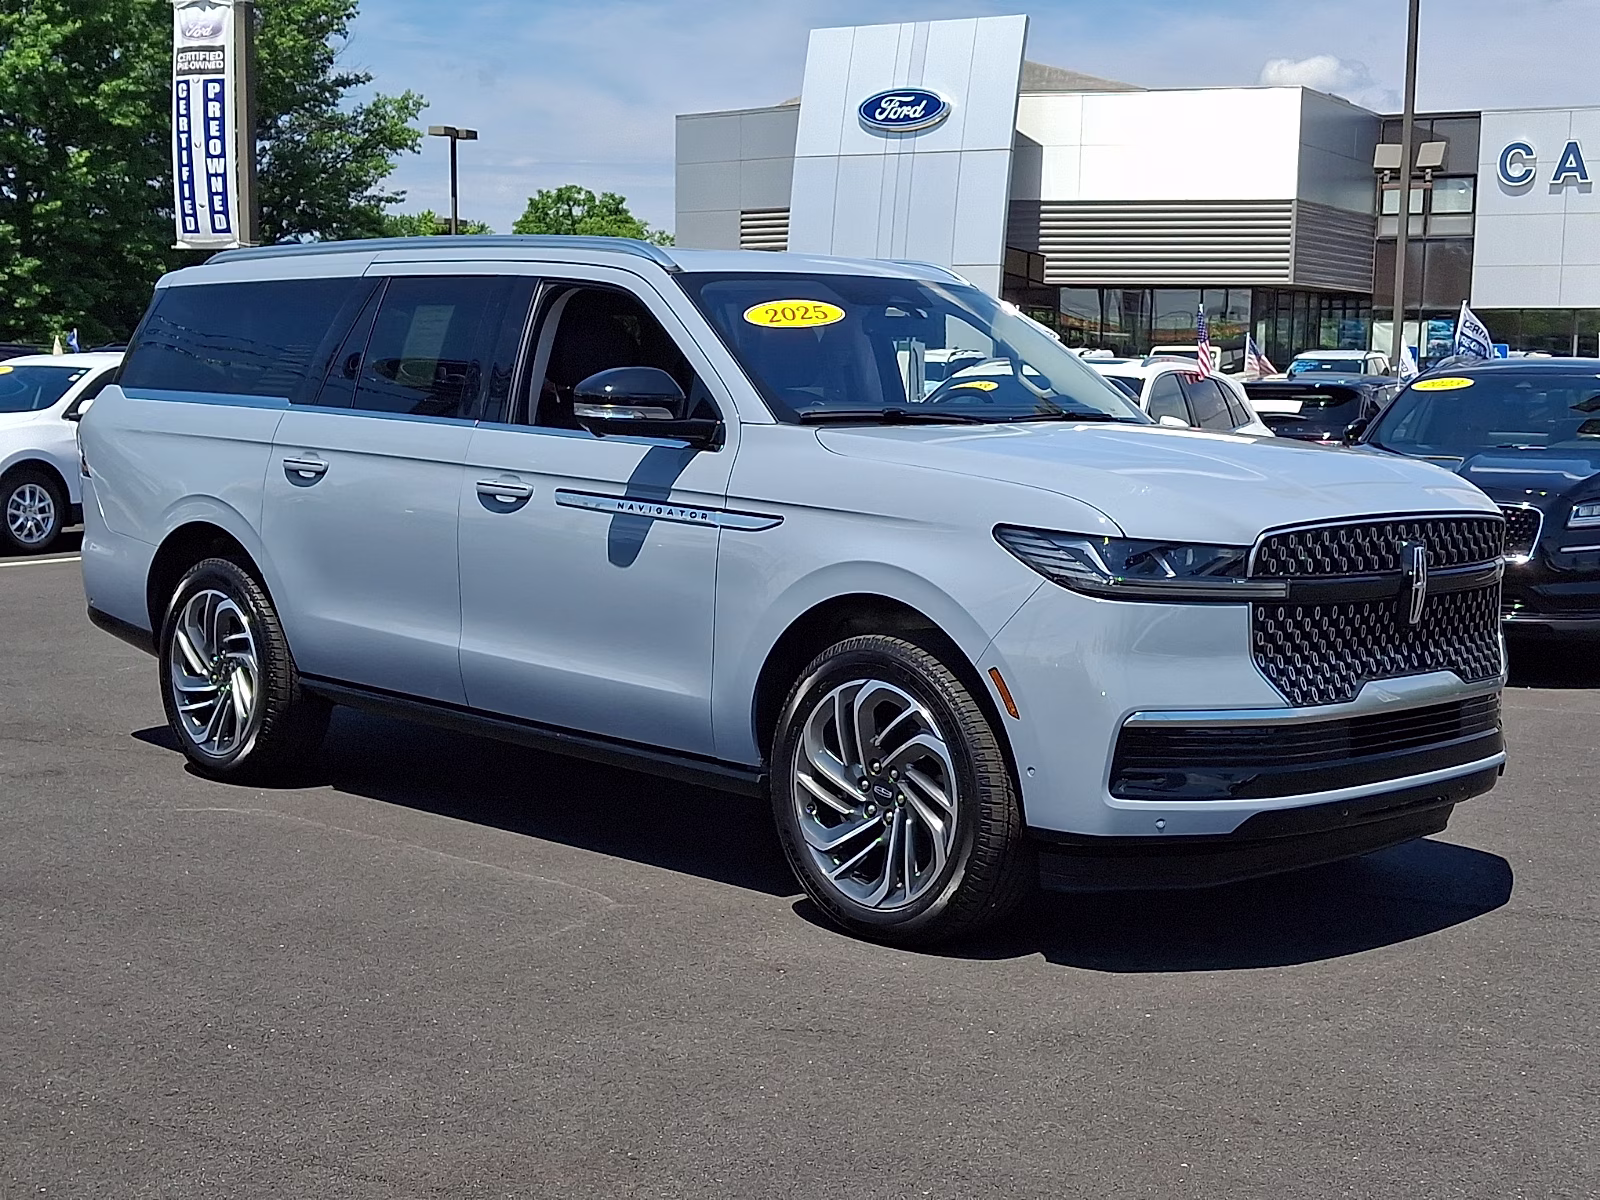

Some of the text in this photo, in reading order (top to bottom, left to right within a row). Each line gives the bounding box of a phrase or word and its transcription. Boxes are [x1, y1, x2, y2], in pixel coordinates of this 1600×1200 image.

[185, 22, 213, 37] Ford
[178, 51, 224, 62] CERTIFIED
[875, 95, 928, 121] Ford
[178, 82, 196, 231] CERTIFIED
[765, 305, 828, 323] 2025
[616, 501, 709, 521] NAVIGATOR
